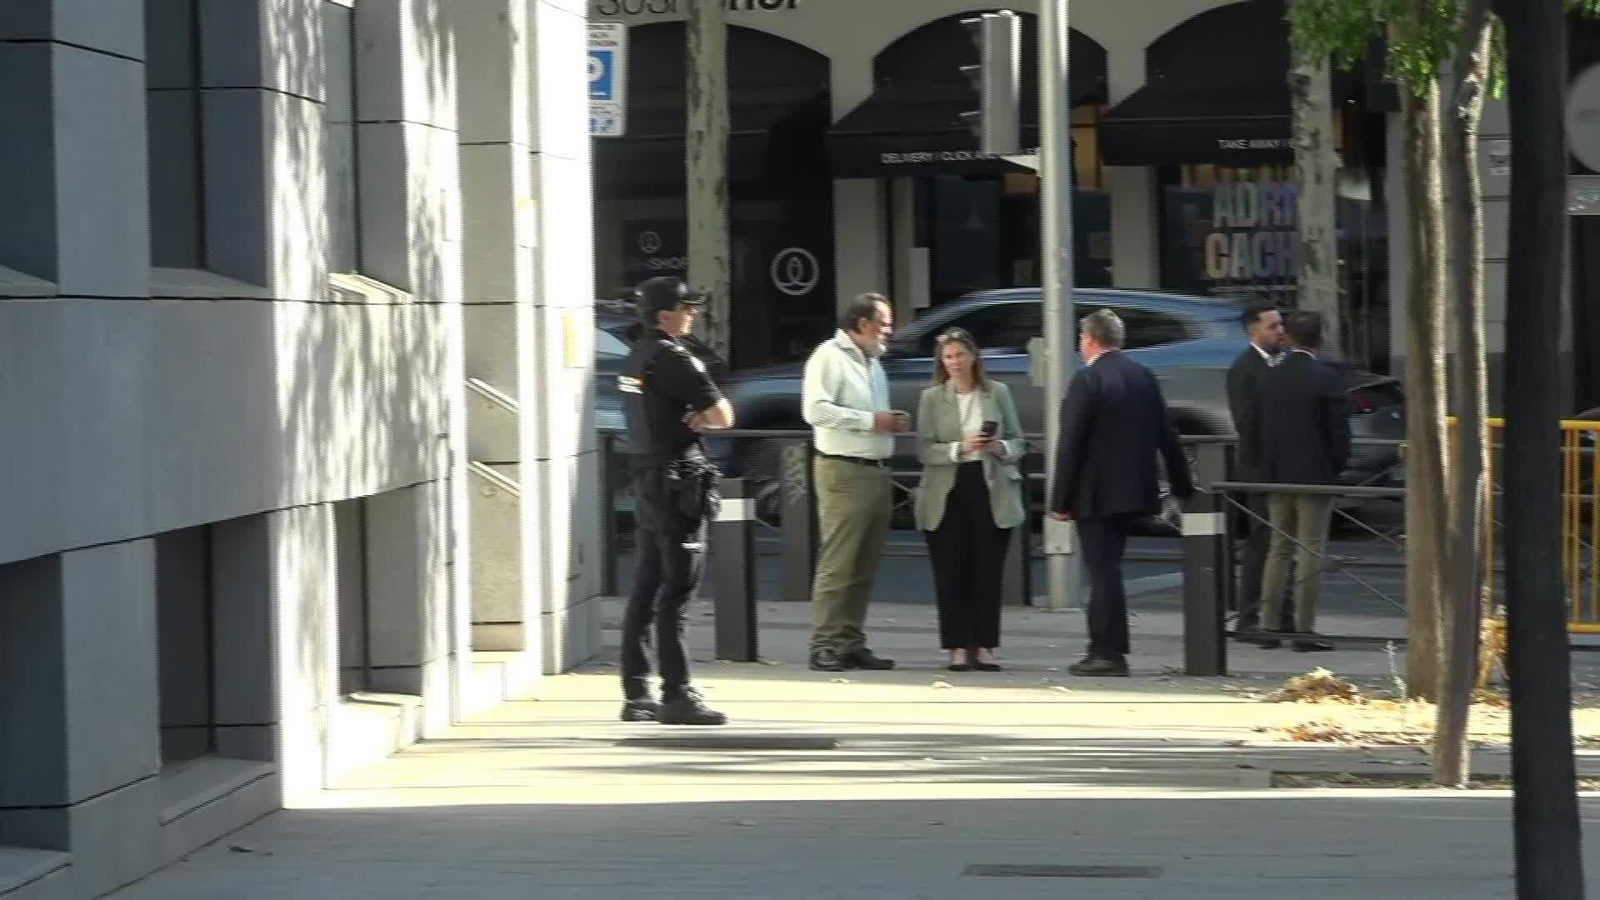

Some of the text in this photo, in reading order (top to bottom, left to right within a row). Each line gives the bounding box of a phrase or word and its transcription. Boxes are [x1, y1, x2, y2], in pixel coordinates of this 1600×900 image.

[1217, 139, 1249, 149] TAKE
[1249, 139, 1280, 149] AWAY
[880, 152, 932, 164] DELIVERY
[941, 150, 973, 161] CLICK
